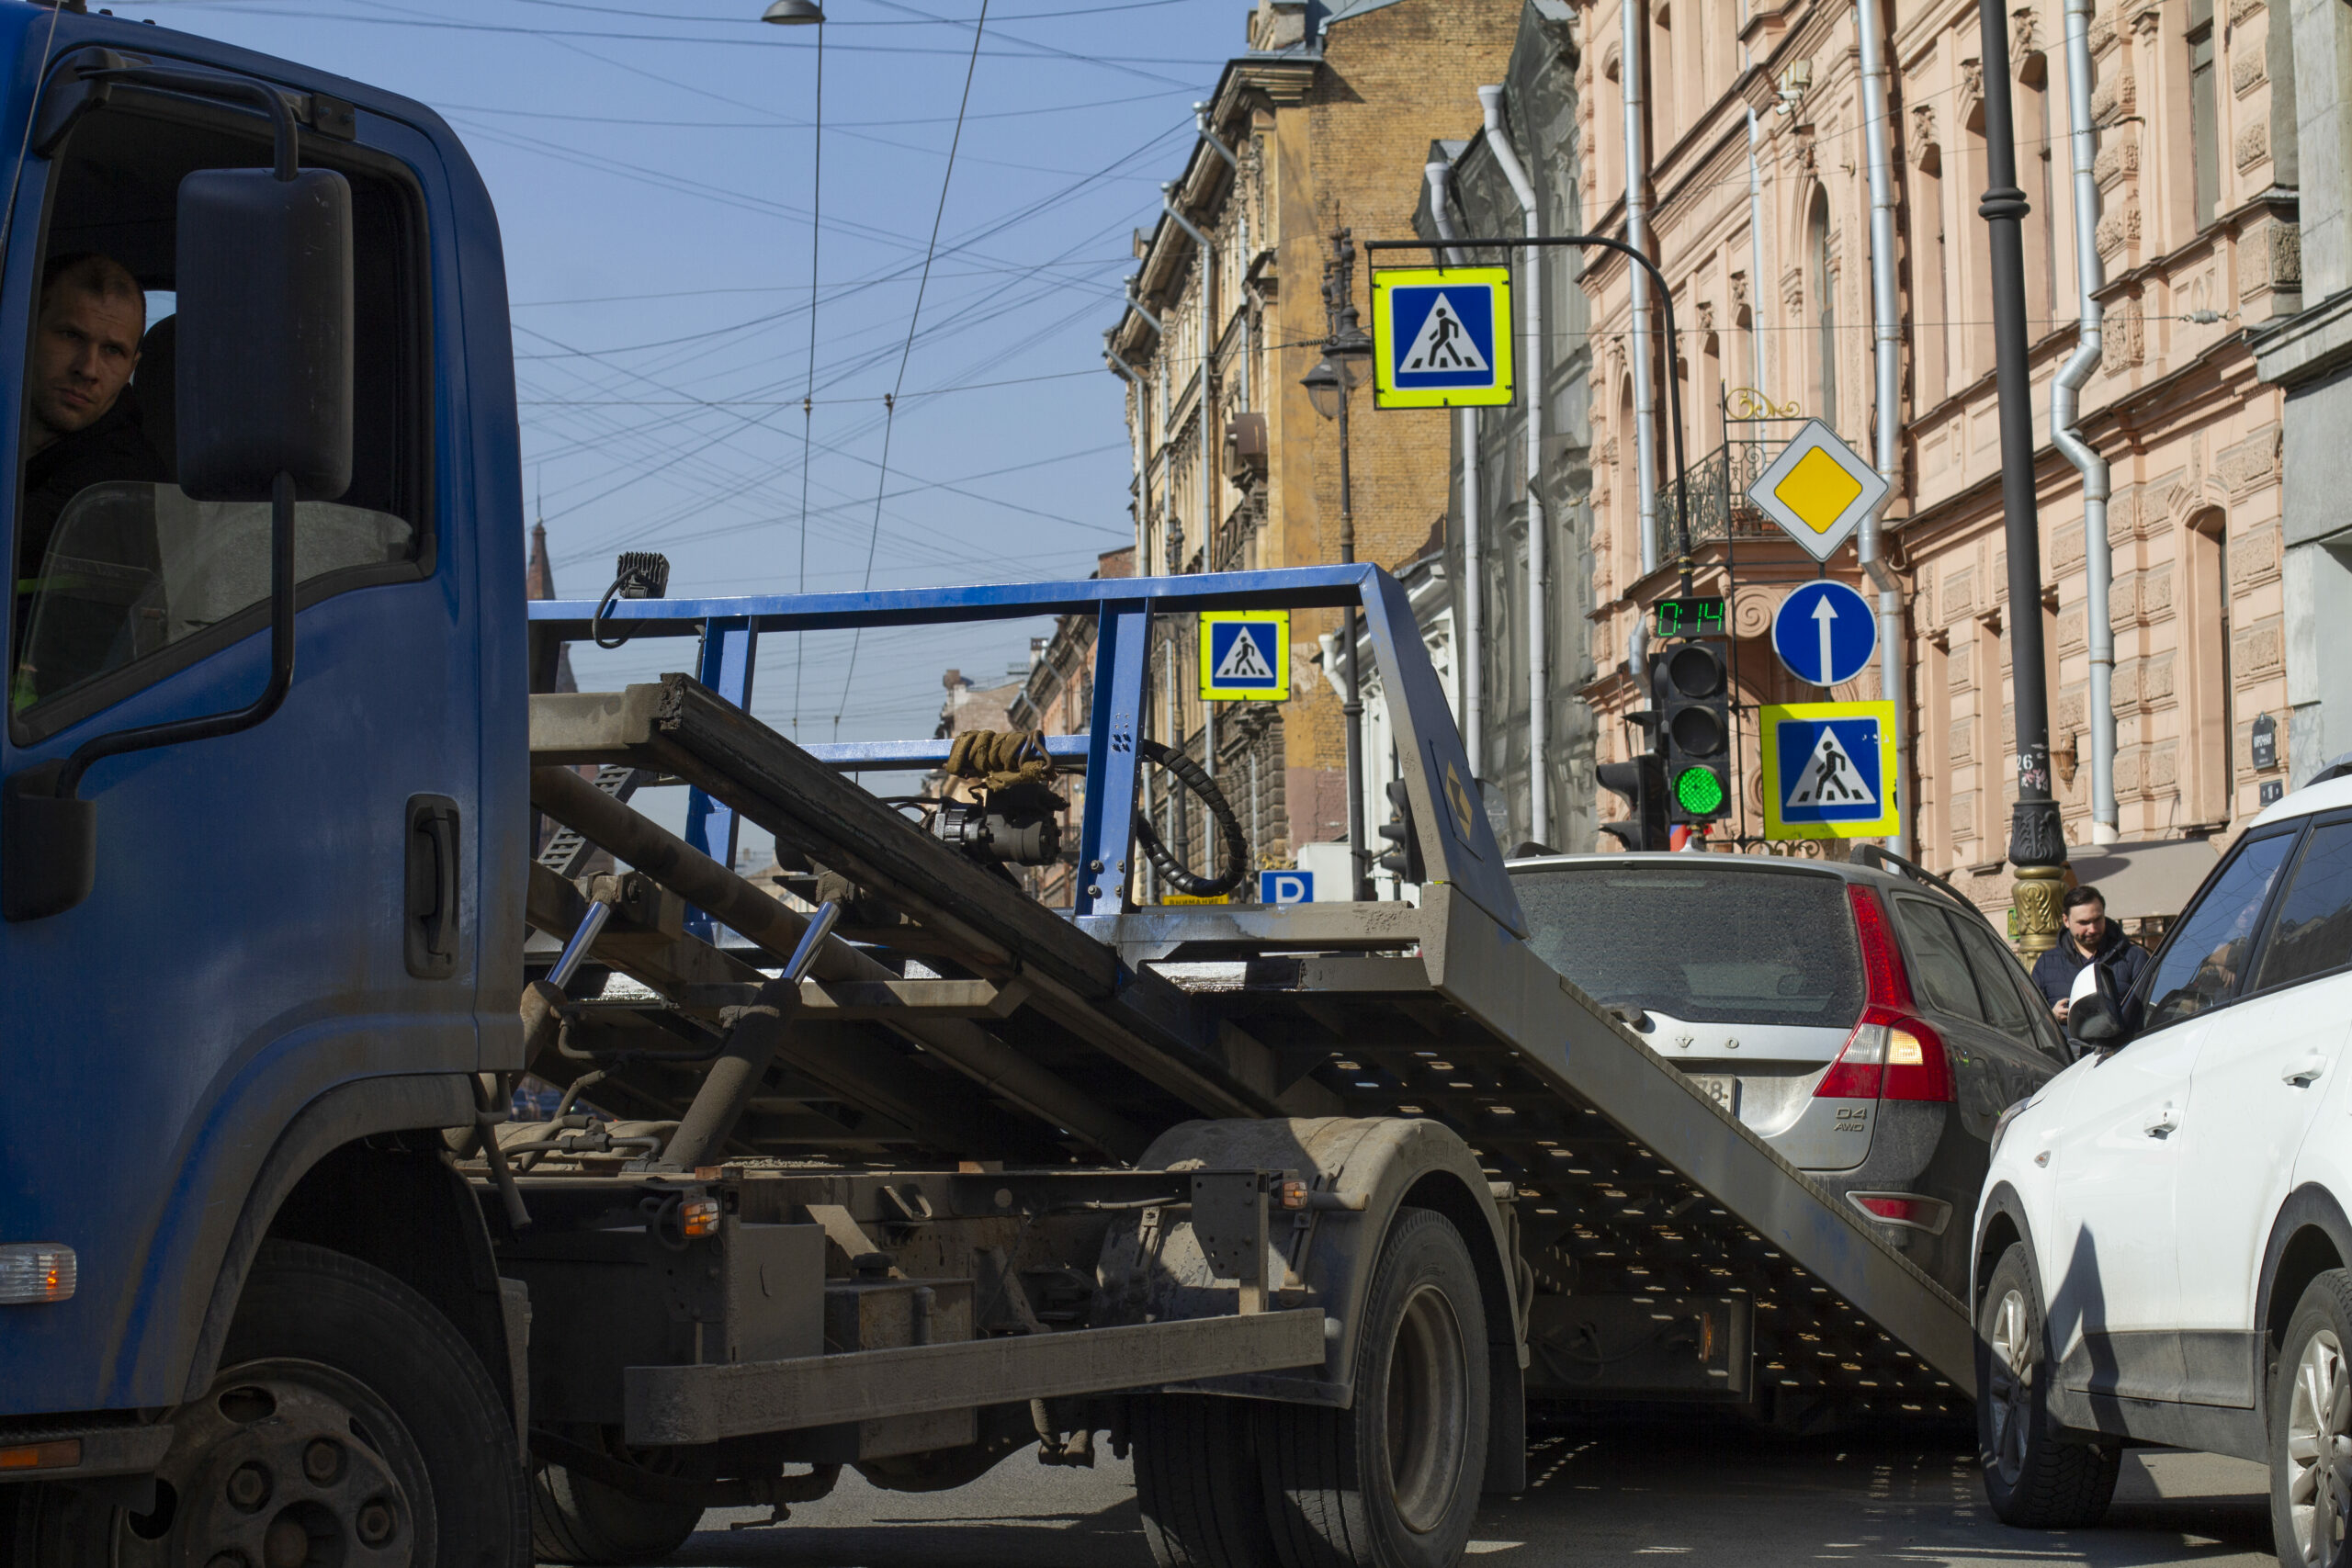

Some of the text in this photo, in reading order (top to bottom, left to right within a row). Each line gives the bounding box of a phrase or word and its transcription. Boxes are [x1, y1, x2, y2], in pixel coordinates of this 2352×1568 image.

[1657, 602, 1724, 637] 0:14
[1836, 1106, 1868, 1120] D4
[1833, 1122, 1864, 1132] AWD
